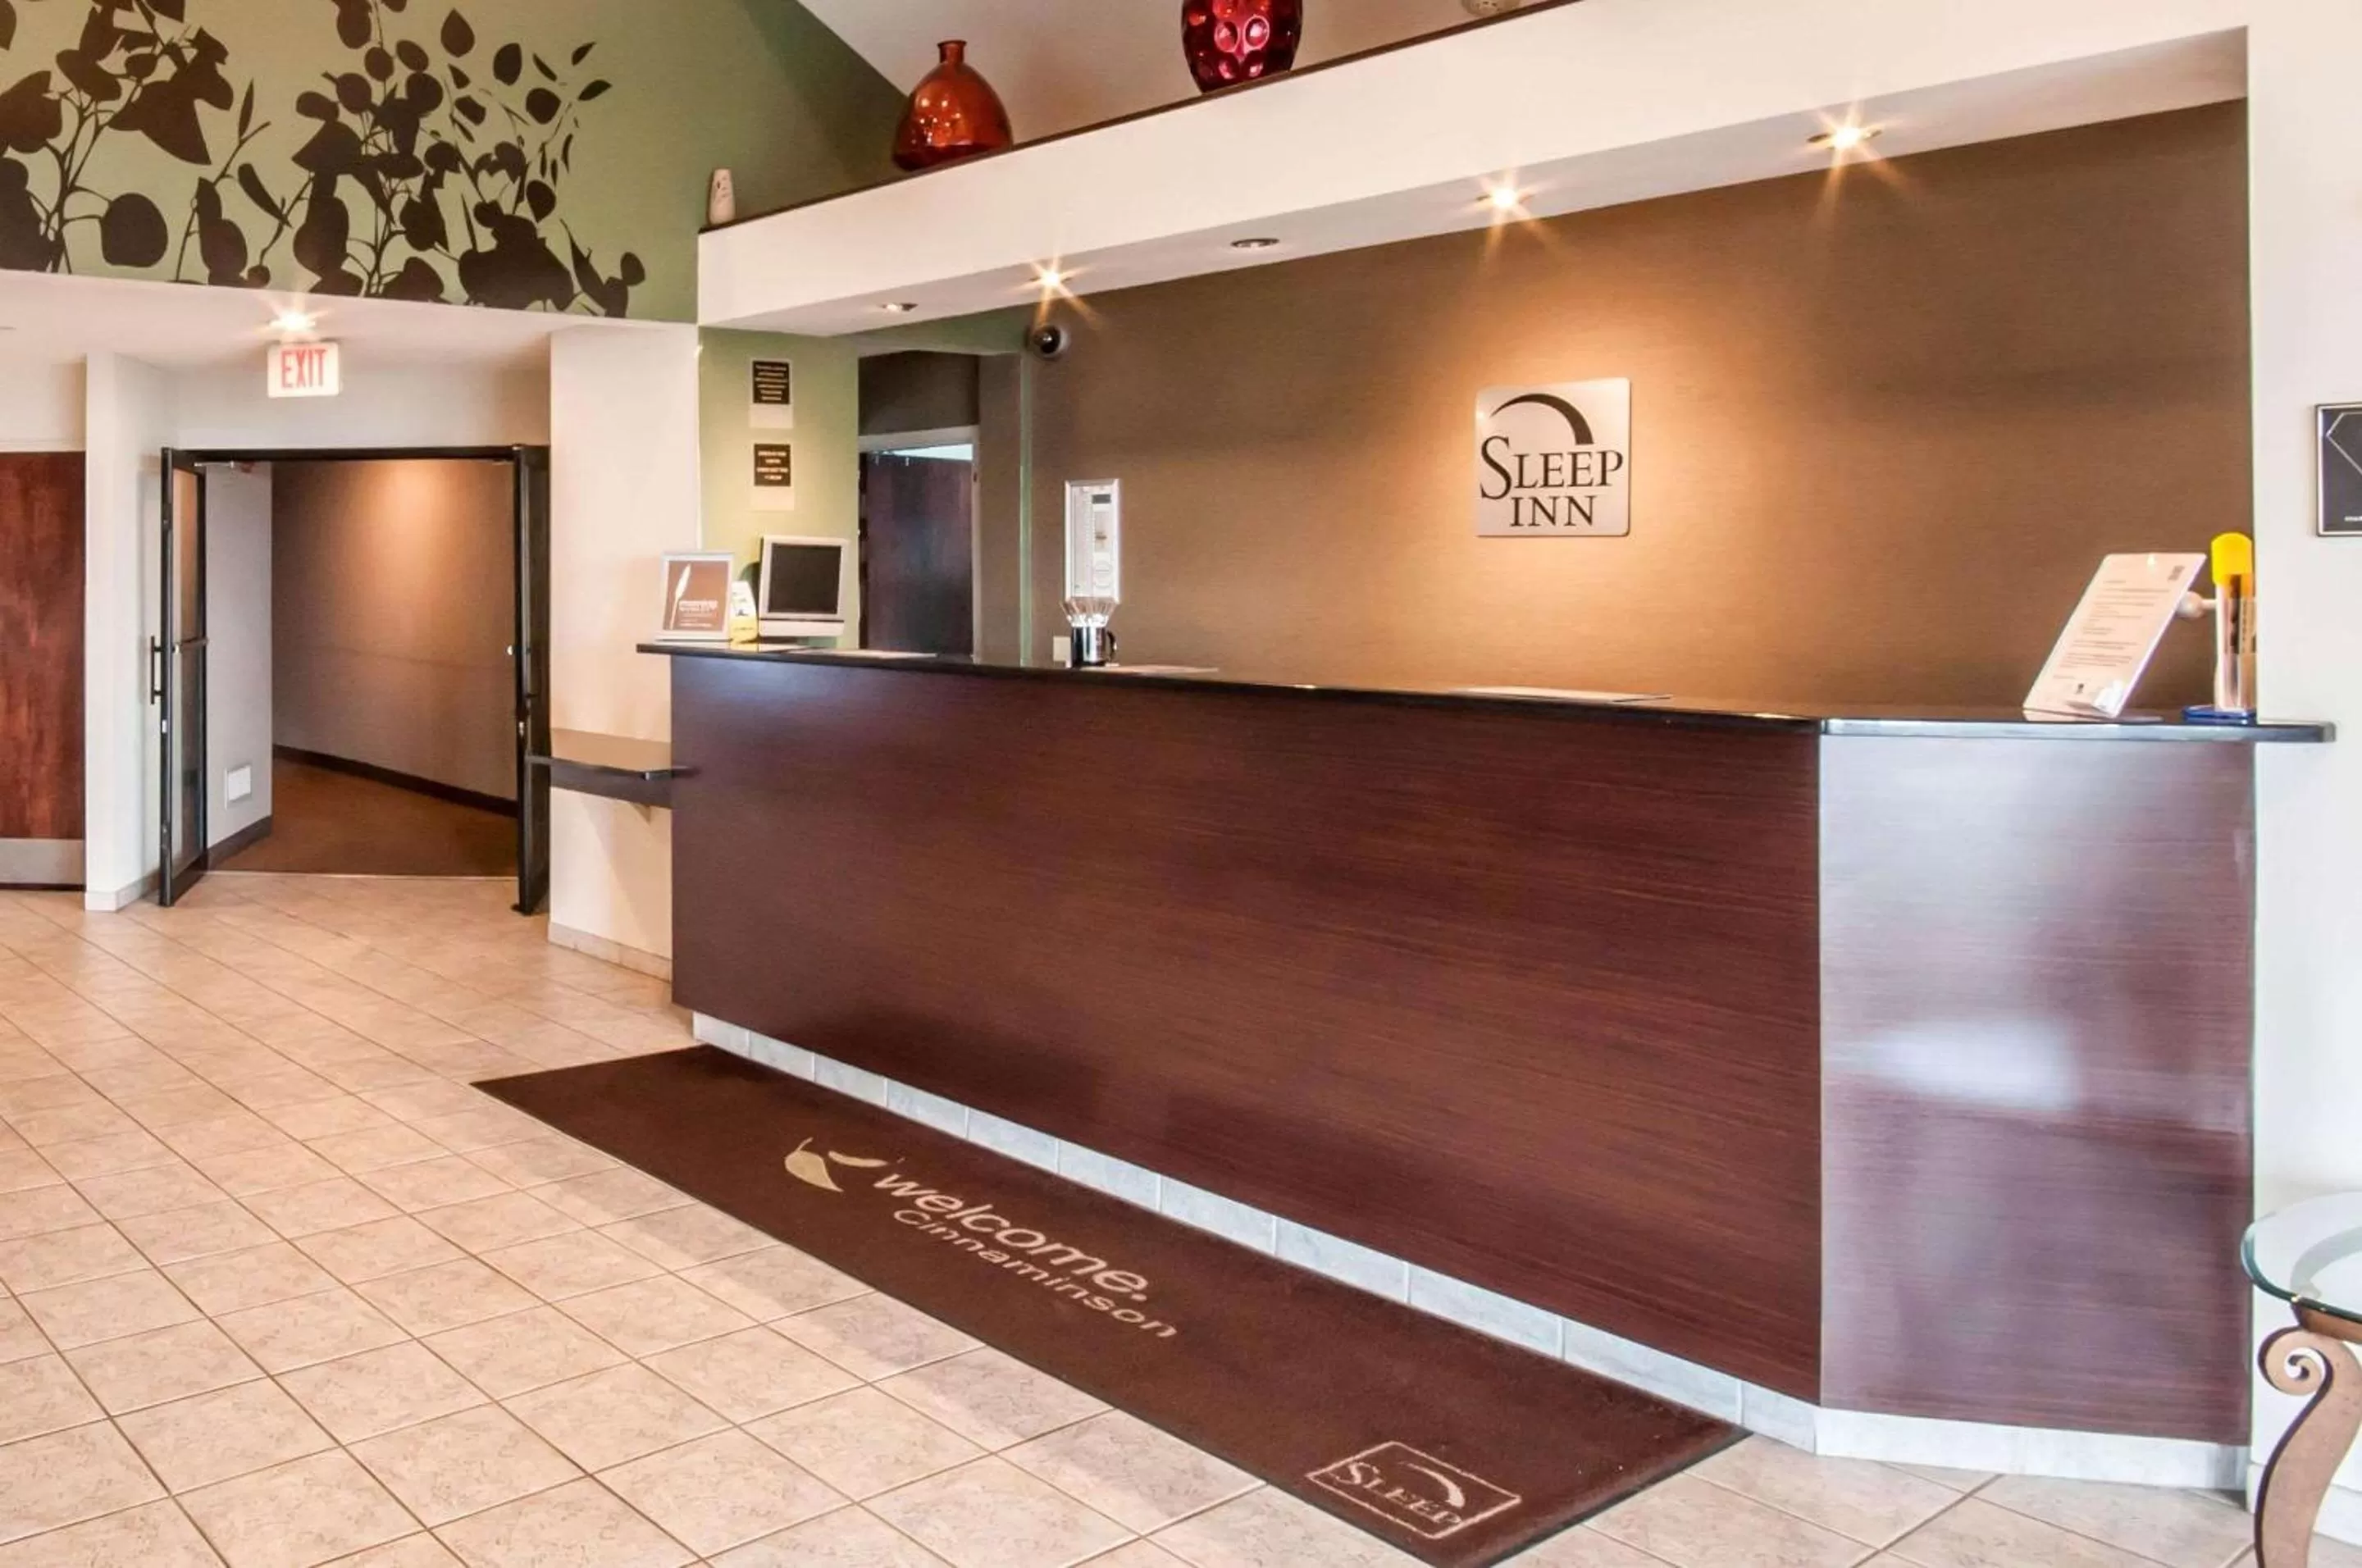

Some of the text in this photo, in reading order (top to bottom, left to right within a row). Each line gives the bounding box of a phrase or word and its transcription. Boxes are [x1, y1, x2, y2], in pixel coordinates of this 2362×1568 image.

[280, 349, 326, 388] EXIT
[1480, 435, 1624, 500] SLEEP
[1510, 495, 1598, 526] INN
[893, 1210, 1179, 1339] Cinnaminson
[1328, 1461, 1462, 1524] SLEEP
